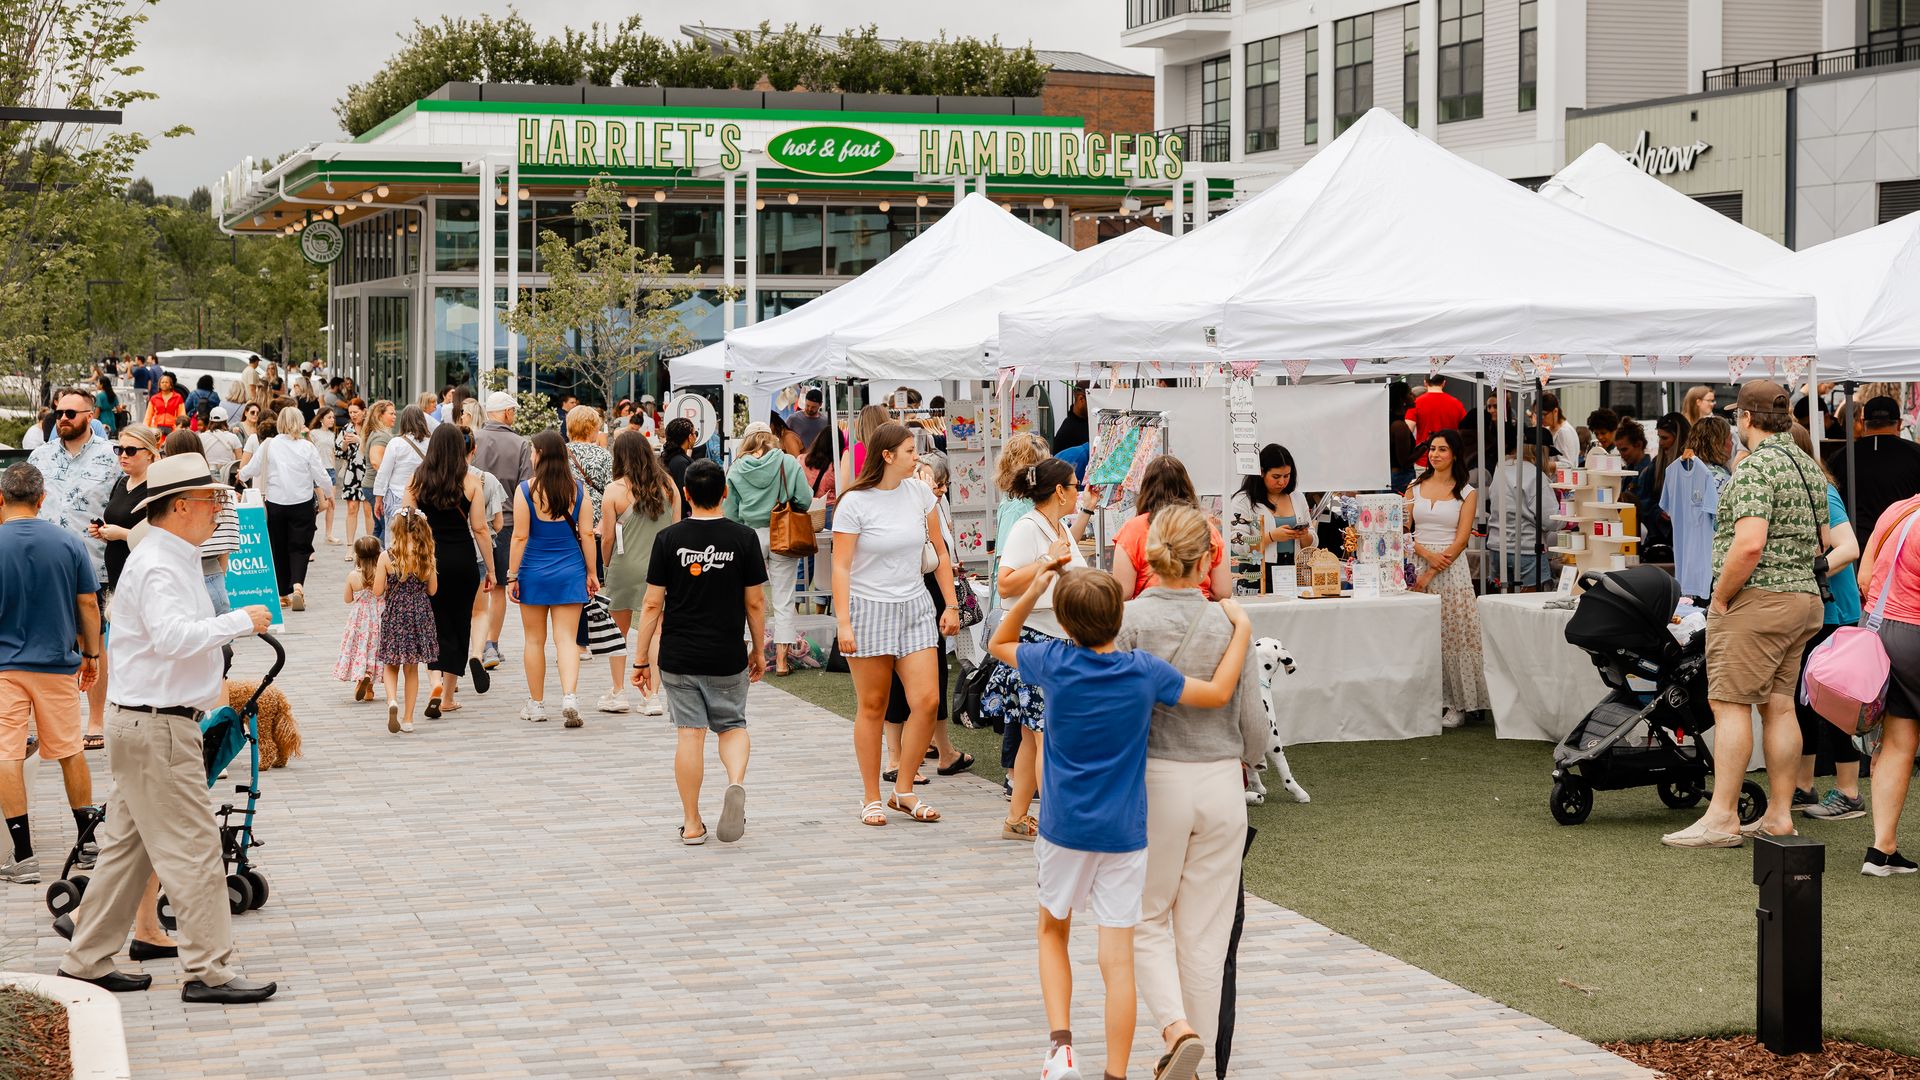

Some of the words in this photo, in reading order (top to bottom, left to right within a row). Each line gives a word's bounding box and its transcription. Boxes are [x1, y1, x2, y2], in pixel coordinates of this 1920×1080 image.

[518, 118, 742, 171] HARRIET'S
[782, 138, 816, 156] hot
[819, 138, 835, 157] &
[837, 139, 881, 163] fast
[919, 129, 1184, 180] HAMBURGERS
[1620, 129, 1711, 175] Arrow
